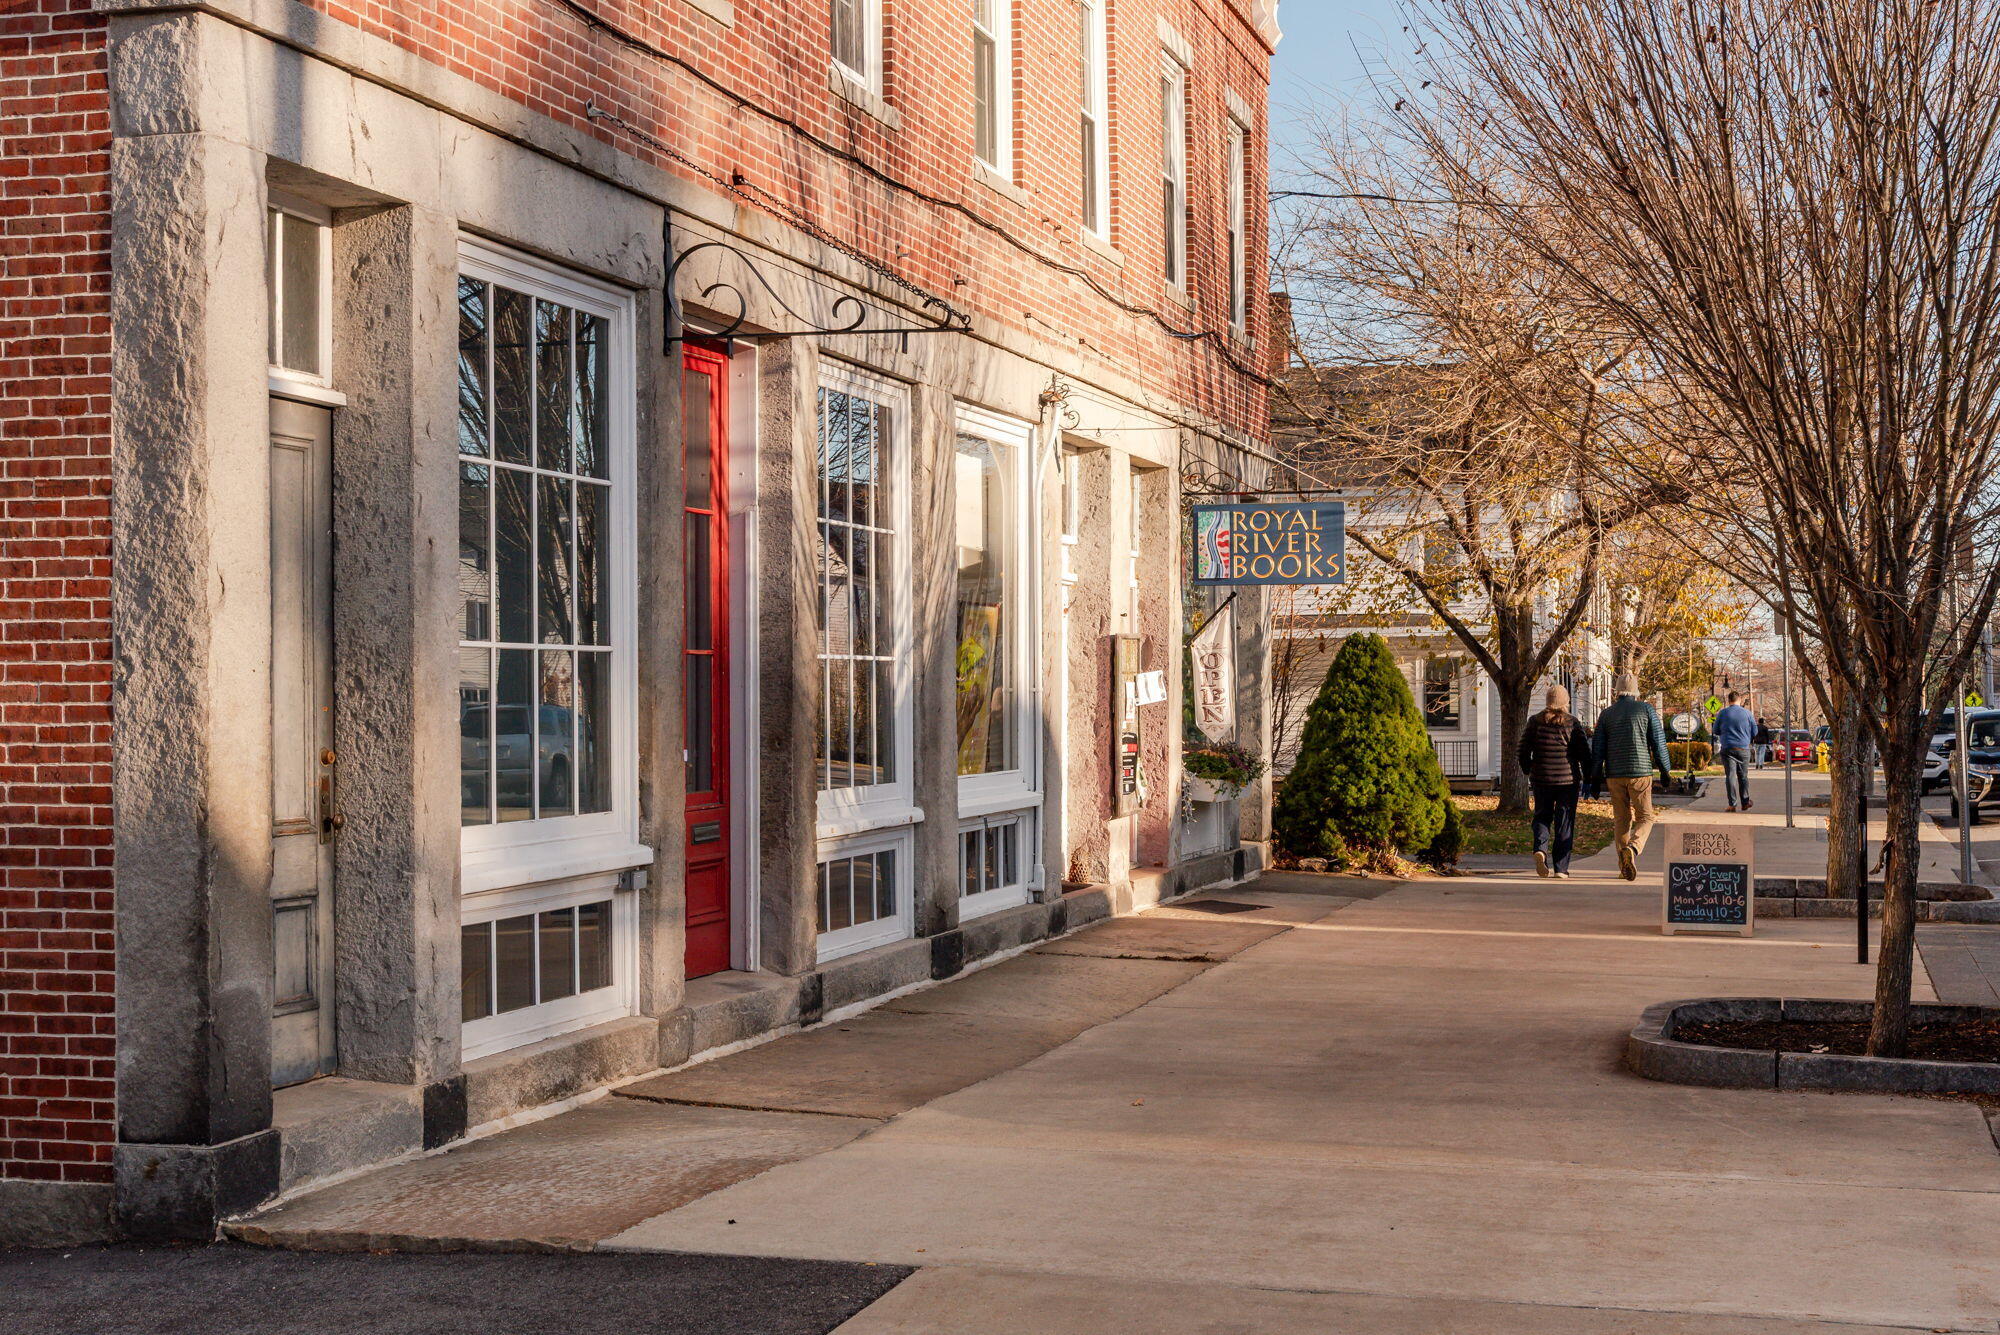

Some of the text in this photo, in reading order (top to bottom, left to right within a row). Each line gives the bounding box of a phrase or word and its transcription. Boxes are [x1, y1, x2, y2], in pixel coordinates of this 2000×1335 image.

[1232, 509, 1323, 532] ROYAL
[1233, 531, 1322, 554] RIVER
[1233, 553, 1340, 579] BOOKS
[1200, 652, 1226, 723] OPEN
[1695, 833, 1731, 841] ROYAL
[1695, 840, 1730, 848] RIVER
[1695, 847, 1737, 856] BOOKS
[1672, 864, 1740, 883] Open Every
[1674, 904, 1713, 920] Sunday
